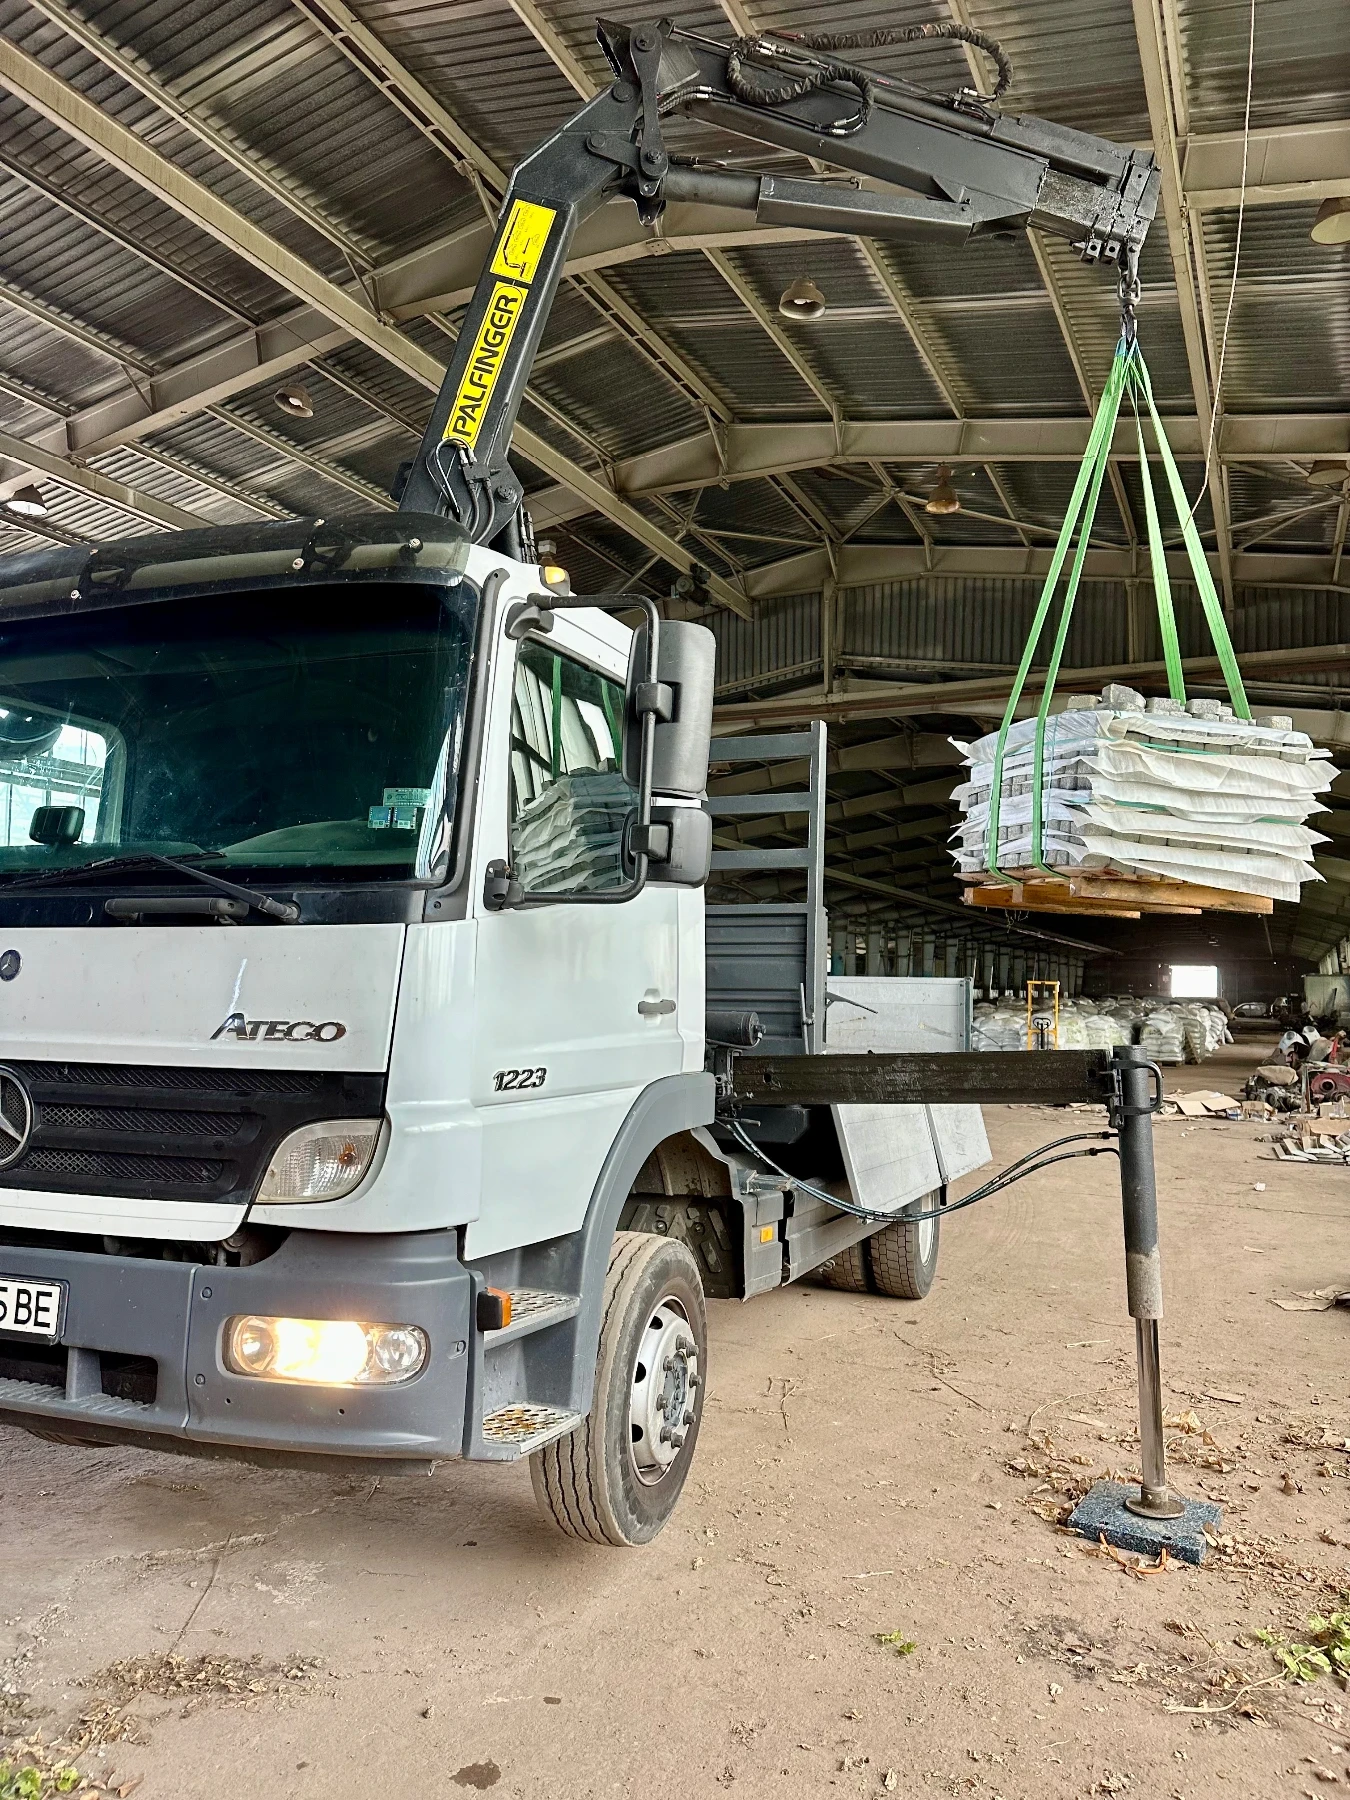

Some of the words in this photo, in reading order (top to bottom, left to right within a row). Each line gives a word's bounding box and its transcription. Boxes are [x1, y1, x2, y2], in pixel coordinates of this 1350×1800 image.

[452, 294, 519, 437] PALFINGER
[493, 1067, 546, 1091] 1223
[14, 1288, 53, 1328] BE
